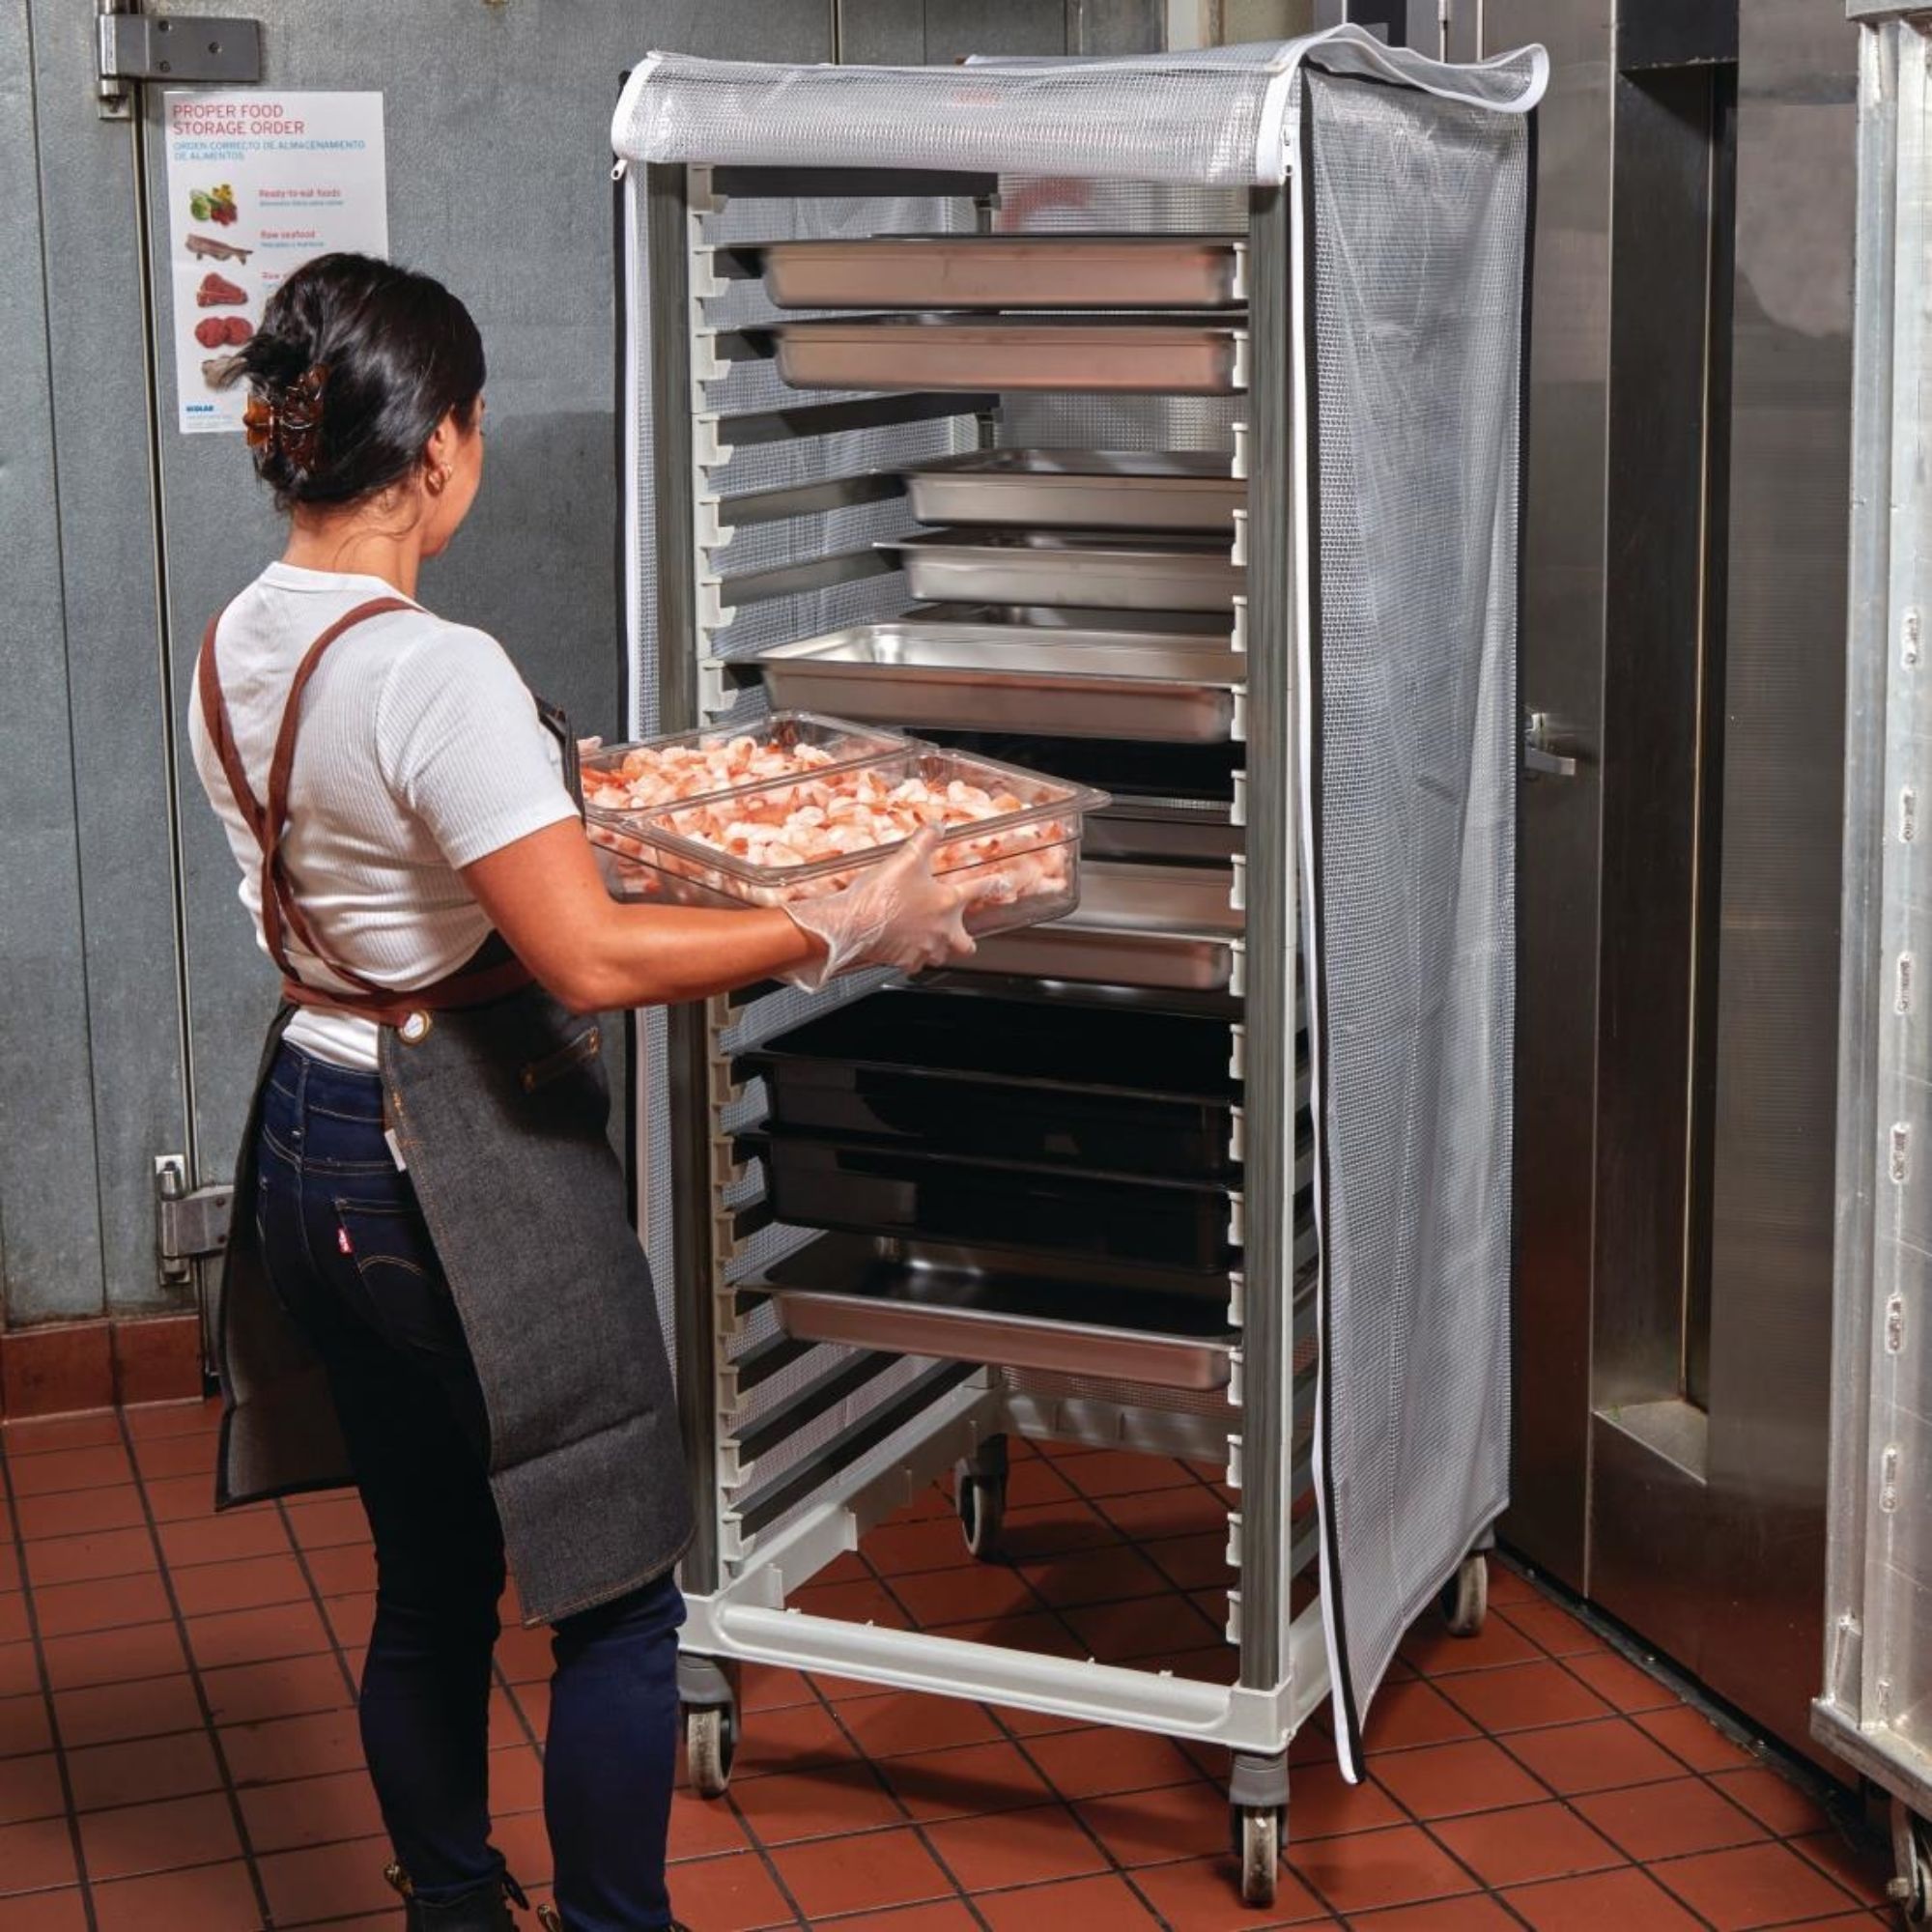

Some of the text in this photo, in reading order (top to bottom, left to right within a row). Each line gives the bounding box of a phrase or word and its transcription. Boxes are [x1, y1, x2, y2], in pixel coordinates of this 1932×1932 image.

[173, 104, 283, 118] PROPER FOOD
[173, 121, 305, 135] STORAGE ORDER
[210, 140, 261, 151] CORRECTO
